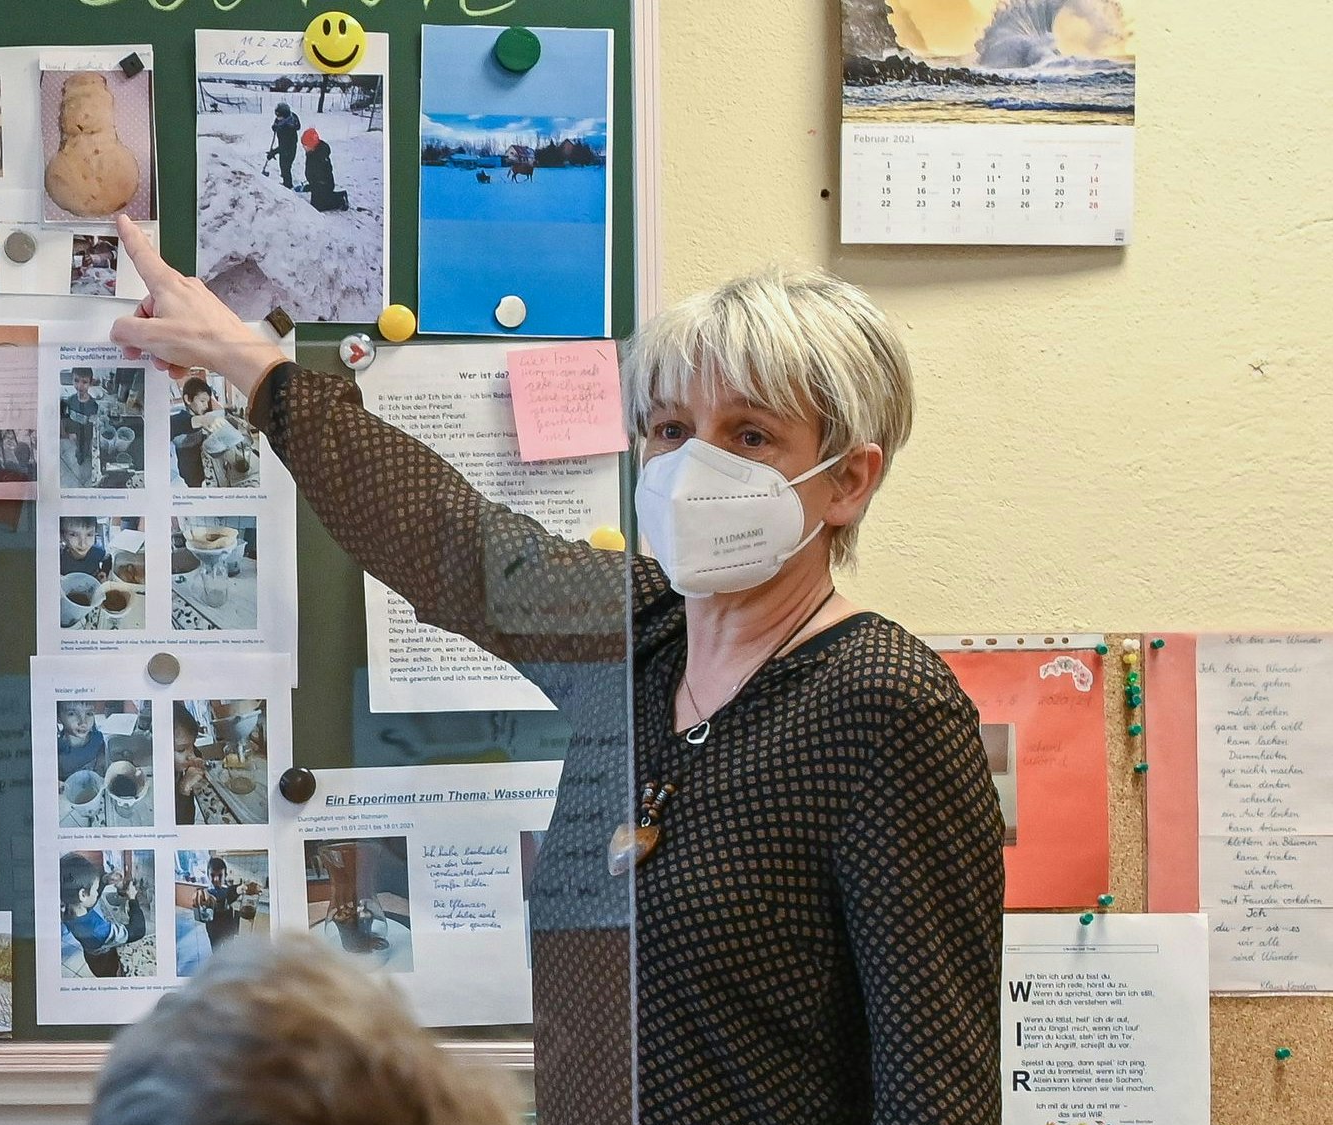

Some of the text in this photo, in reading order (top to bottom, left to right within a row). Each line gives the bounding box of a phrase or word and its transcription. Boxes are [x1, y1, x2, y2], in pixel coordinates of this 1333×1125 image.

[214, 50, 304, 66] Richard und
[854, 134, 914, 144] Februar 2021
[494, 371, 510, 379] da?
[325, 795, 345, 806] Ein
[348, 794, 417, 806] Experiment
[419, 793, 444, 802] zum
[448, 791, 490, 802] Thema:
[1246, 908, 1267, 918] Ich
[1259, 937, 1280, 947] alle
[1009, 981, 1032, 1002] W
[1017, 1022, 1021, 1046] I
[1013, 1071, 1031, 1091] R
